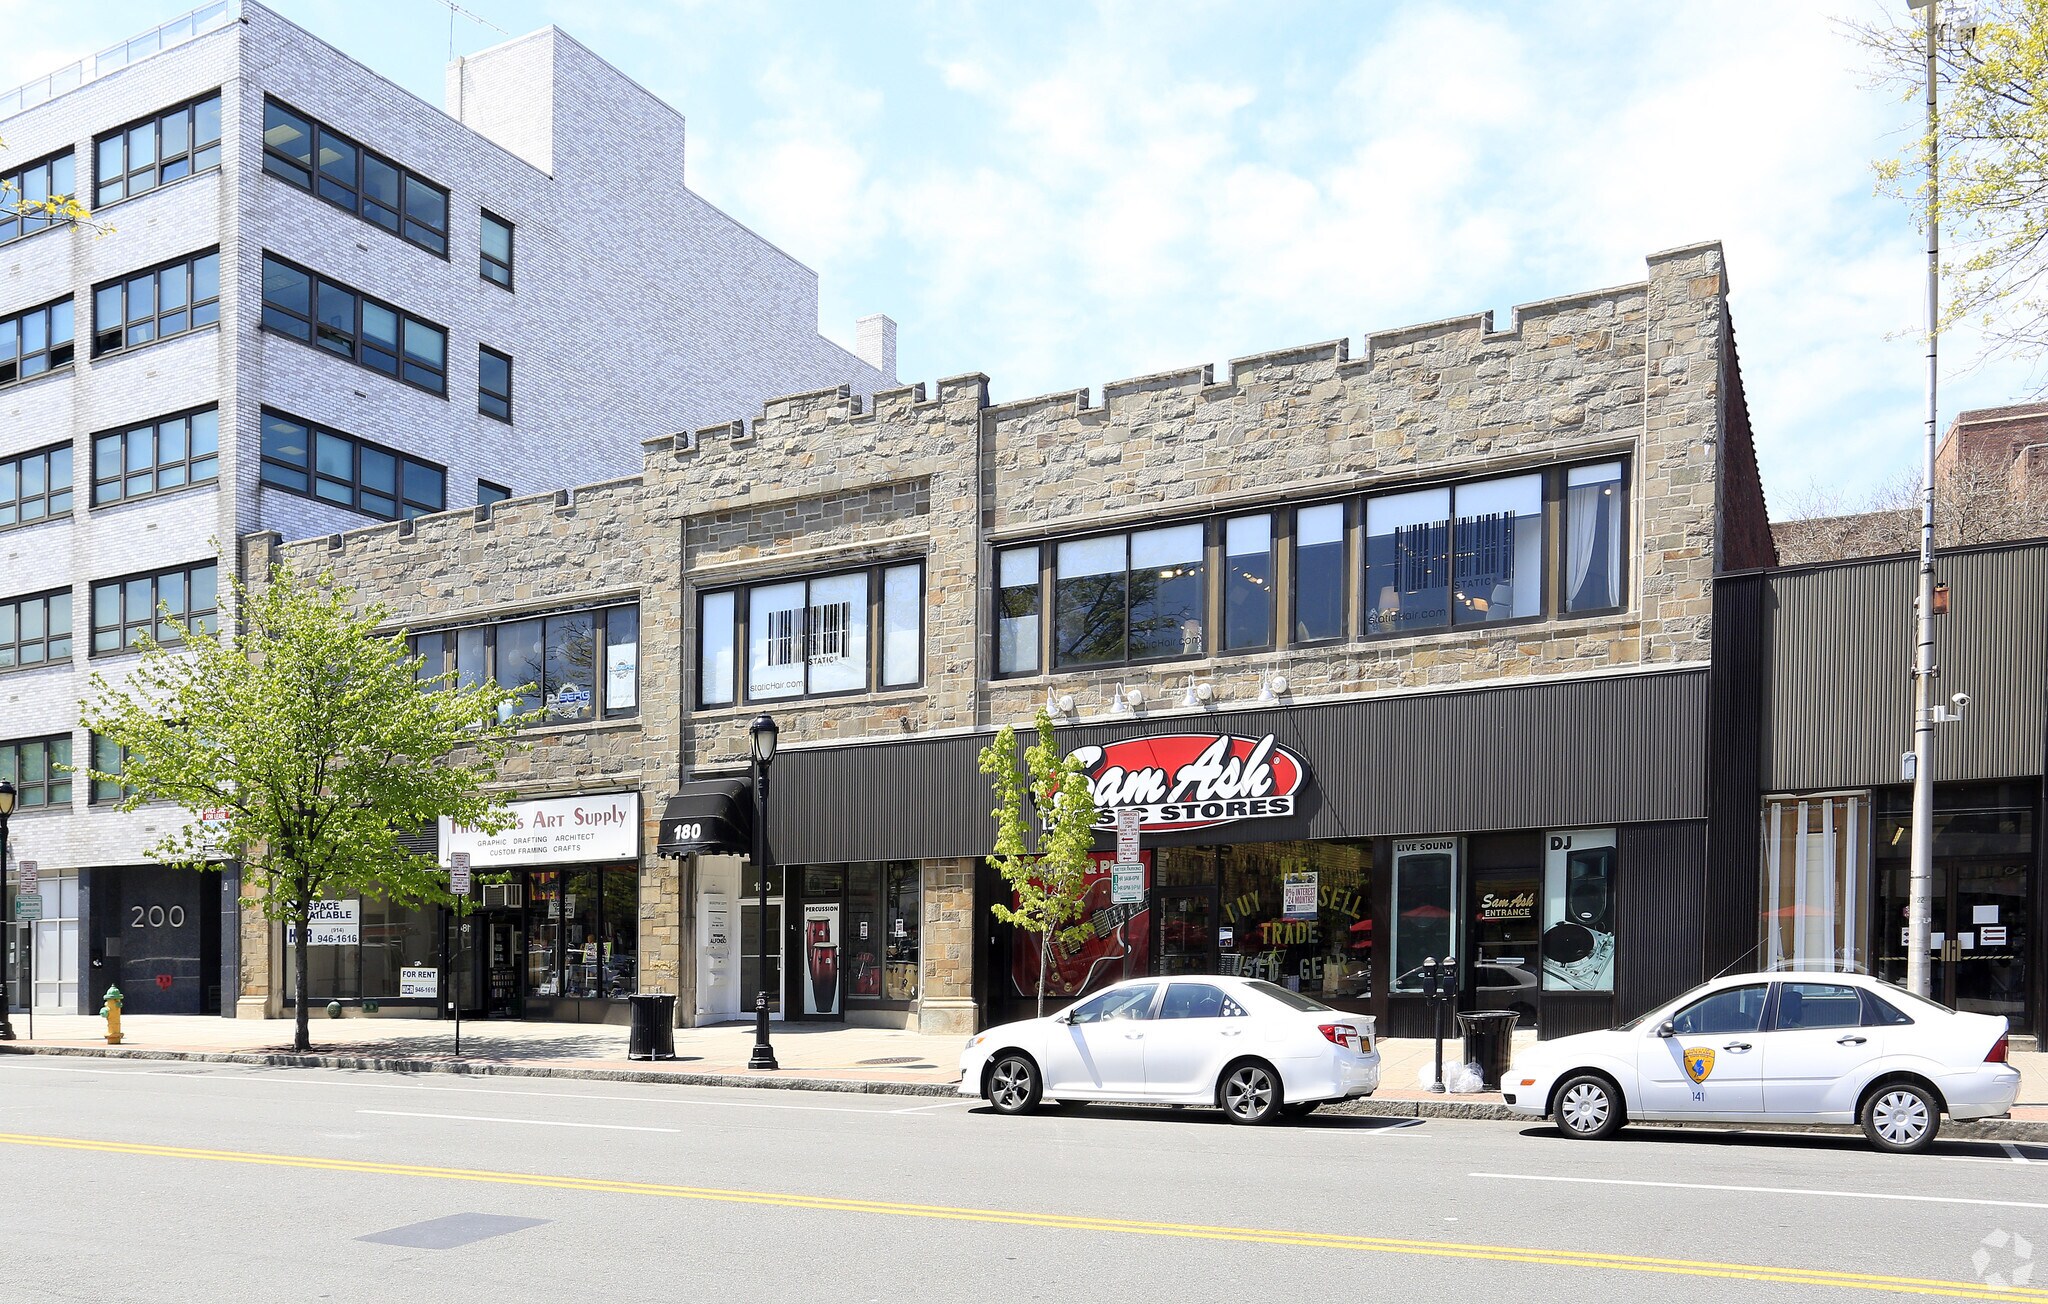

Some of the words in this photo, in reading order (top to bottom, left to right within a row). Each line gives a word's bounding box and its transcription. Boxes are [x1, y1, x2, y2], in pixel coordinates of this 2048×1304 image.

[1454, 577, 1491, 589] STATIC
[808, 656, 834, 665] STATIC
[1167, 734, 1273, 804] Ash
[1160, 798, 1290, 821] STORES
[673, 823, 702, 840] 180
[477, 838, 507, 847] GRAPHIC
[513, 836, 548, 845] DRAFTING
[556, 832, 595, 842] ARCHITECT
[1550, 836, 1572, 850] DJ
[490, 848, 516, 857] CUSTOM
[518, 846, 548, 855] FRAMING
[553, 844, 581, 853] CRAFTS
[1397, 844, 1417, 852] LIVE
[1419, 842, 1454, 850] SOUND
[754, 882, 772, 892] 10
[308, 902, 340, 911] SPACE
[1318, 885, 1362, 920] SELL
[1481, 893, 1509, 909] Sam
[1508, 892, 1535, 907] Ash
[805, 905, 838, 913] PERCUSSION
[1485, 908, 1530, 917] ENTRANCE
[131, 905, 185, 928] 200
[317, 934, 357, 943] 946-1616
[1261, 921, 1319, 945] TRADE
[1232, 953, 1280, 982] USED
[402, 970, 417, 978] FOR
[417, 971, 437, 979] RENT
[1692, 1091, 1705, 1102] 141
